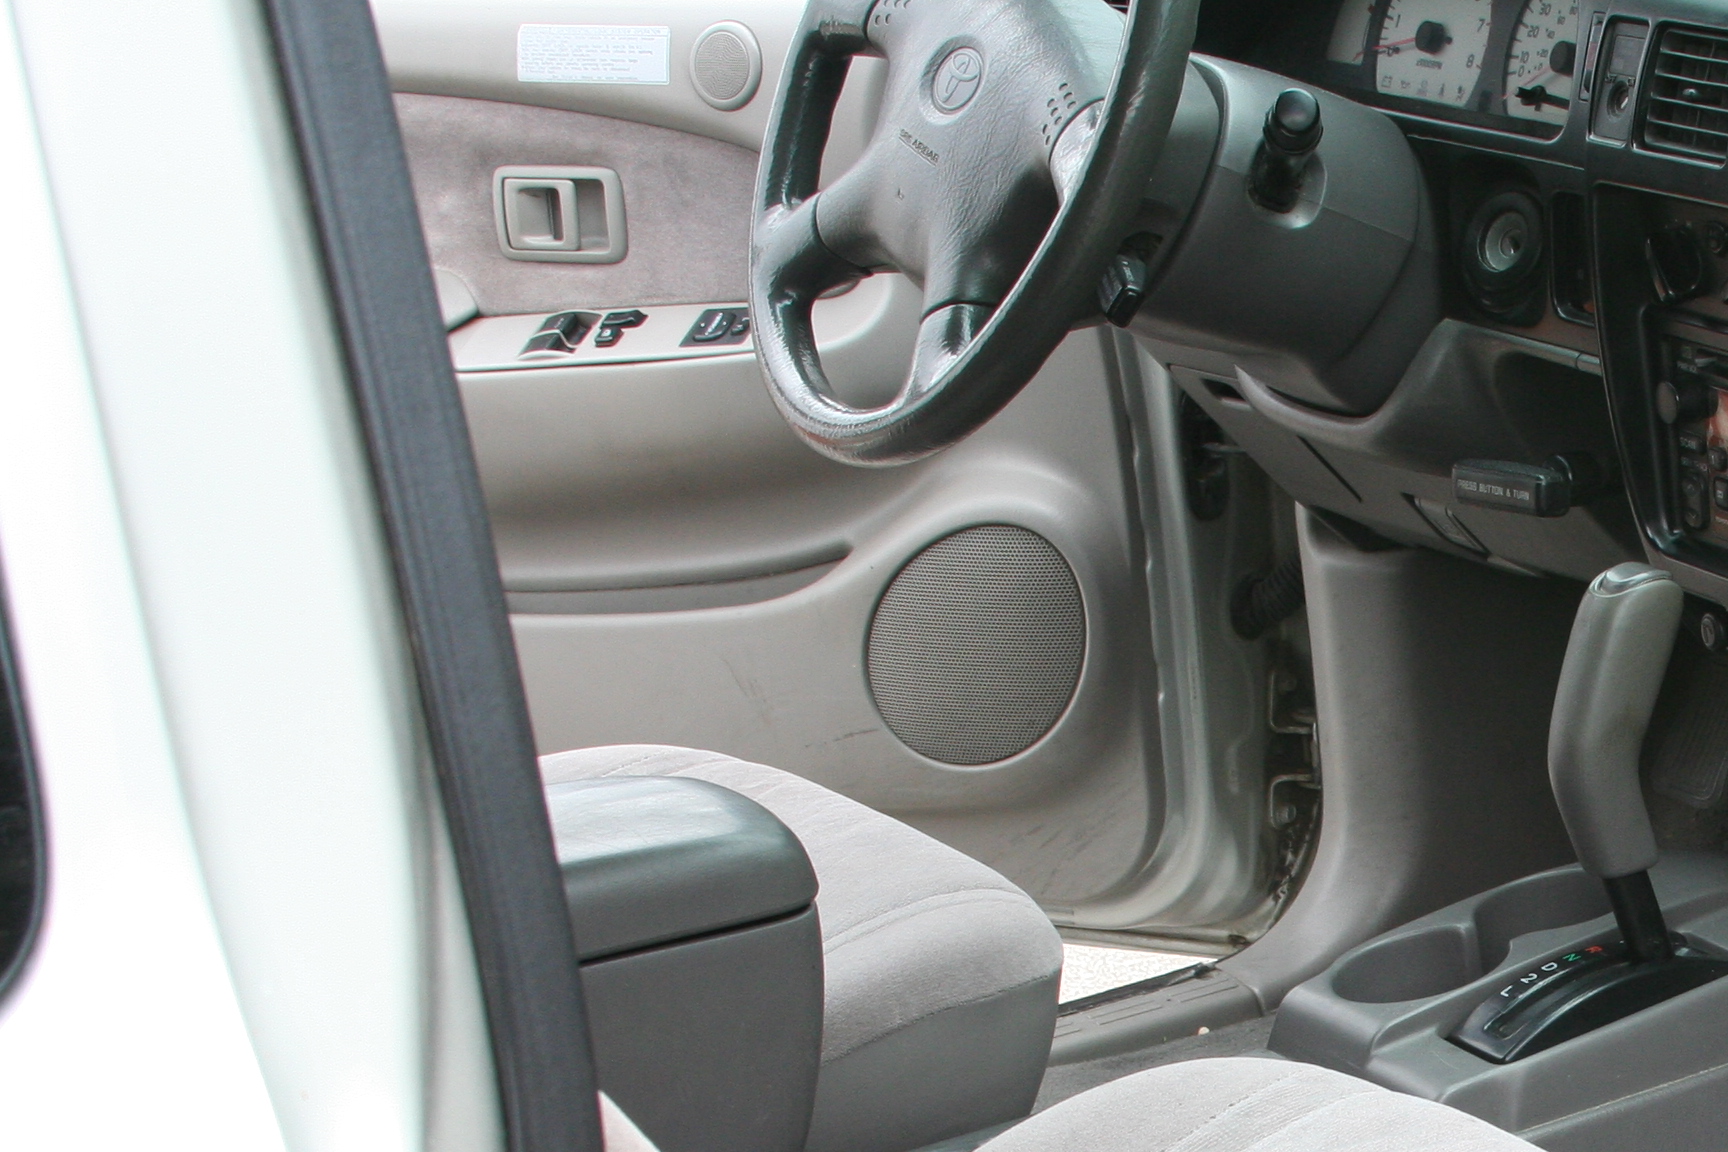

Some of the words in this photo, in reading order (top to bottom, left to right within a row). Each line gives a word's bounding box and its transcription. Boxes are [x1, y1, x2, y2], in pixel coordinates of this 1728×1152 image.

[1539, 3, 1551, 16] 30
[1396, 14, 1401, 28] 1
[1477, 18, 1486, 32] 7
[1527, 25, 1539, 38] 20
[1466, 53, 1475, 68] 8
[1520, 51, 1529, 64] 10
[1518, 65, 1524, 77] 0
[912, 139, 940, 163] AIRBAG
[1457, 479, 1477, 492] PRESS
[1479, 483, 1504, 496] BUTTON
[1506, 488, 1511, 498] &
[1513, 489, 1530, 501] TURN
[1584, 945, 1603, 954] R
[1562, 953, 1582, 962] N
[1541, 962, 1558, 972] D
[1520, 973, 1538, 984] 2
[1500, 985, 1514, 998] L
